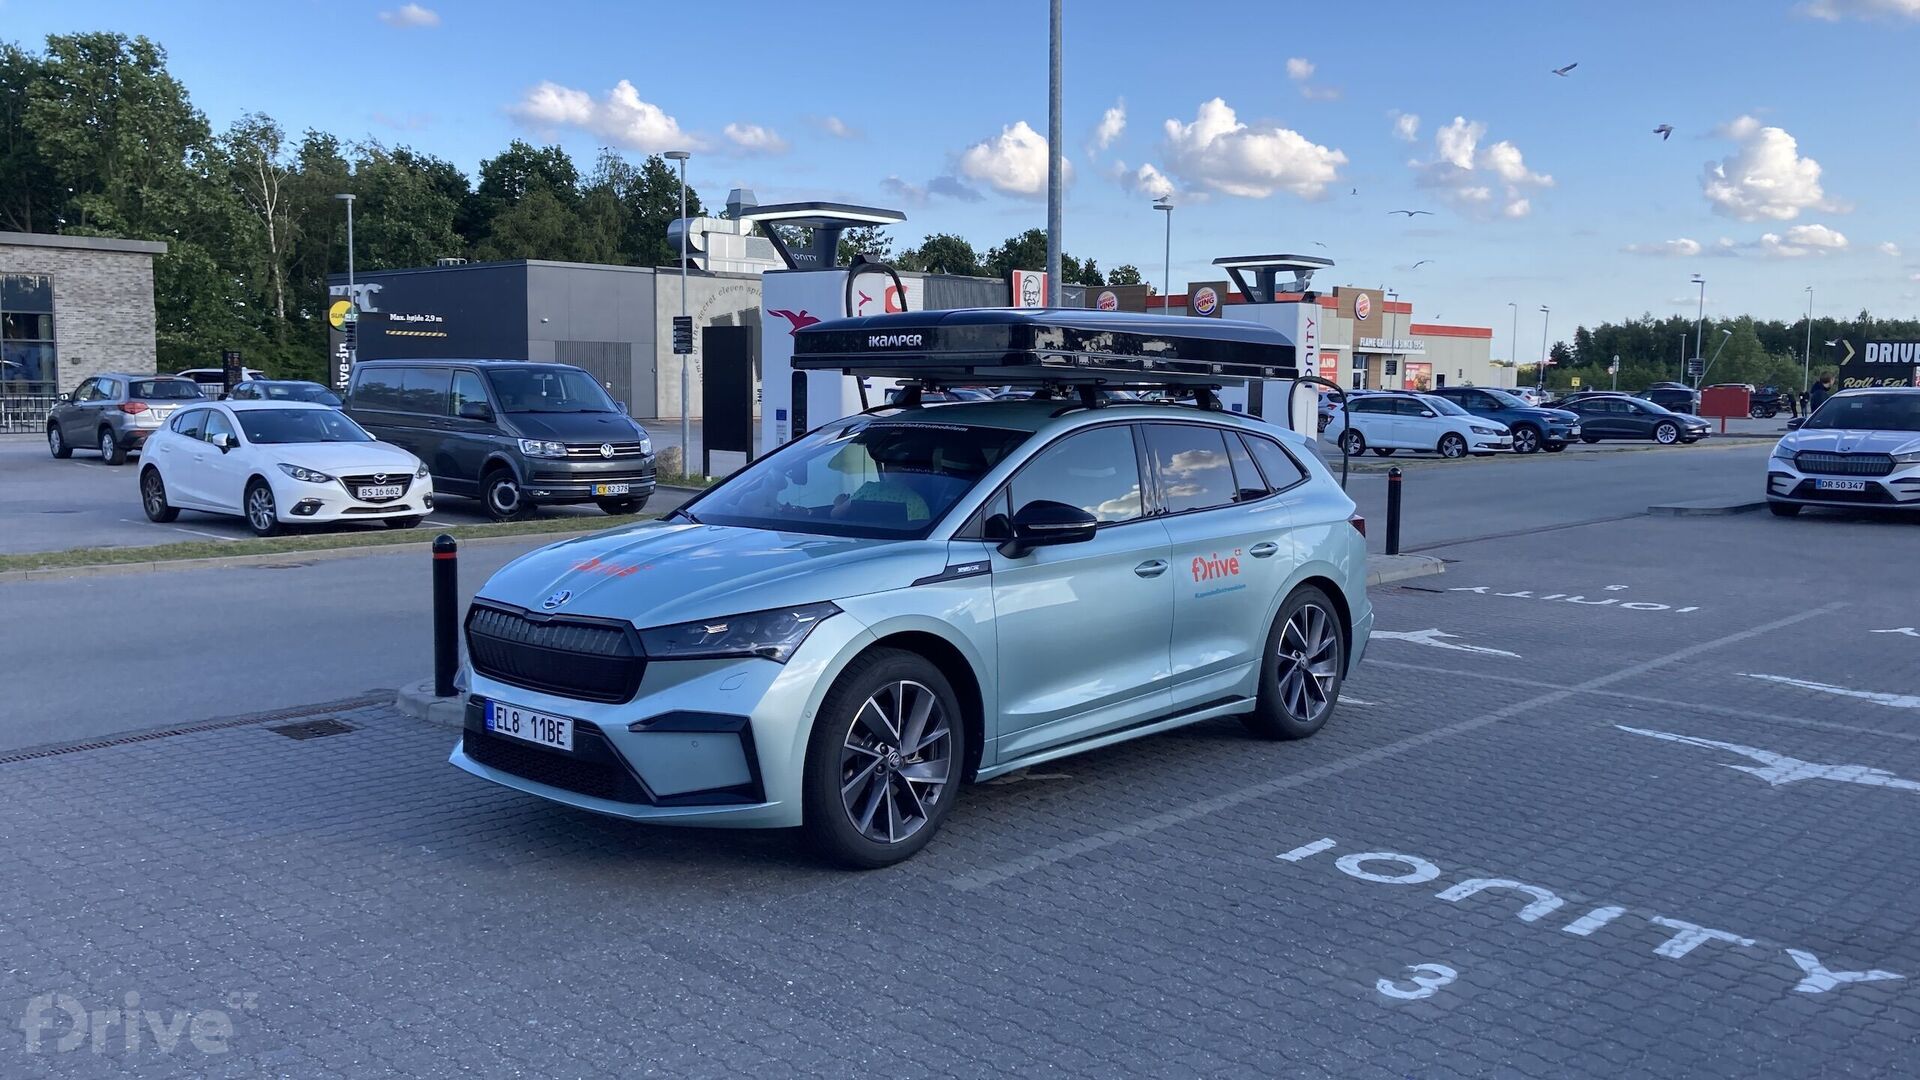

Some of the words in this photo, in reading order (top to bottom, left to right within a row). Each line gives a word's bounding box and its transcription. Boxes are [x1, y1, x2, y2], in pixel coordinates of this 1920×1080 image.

[1198, 297, 1214, 308] KING
[390, 313, 406, 321] Max.
[424, 314, 435, 322] 2,9
[1360, 337, 1376, 347] FLAME
[336, 343, 349, 390] ive-in
[1843, 376, 1874, 388] Roll
[1822, 480, 1833, 488] DR
[1835, 481, 1846, 489] 50
[361, 488, 373, 496] BS
[375, 488, 384, 496] 16
[386, 487, 399, 495] 662
[1448, 585, 1700, 613] IONITY
[496, 707, 520, 734] EL8
[531, 715, 565, 746] 11BE
[1276, 837, 1905, 993] IONITY
[1377, 963, 1458, 999] 3
